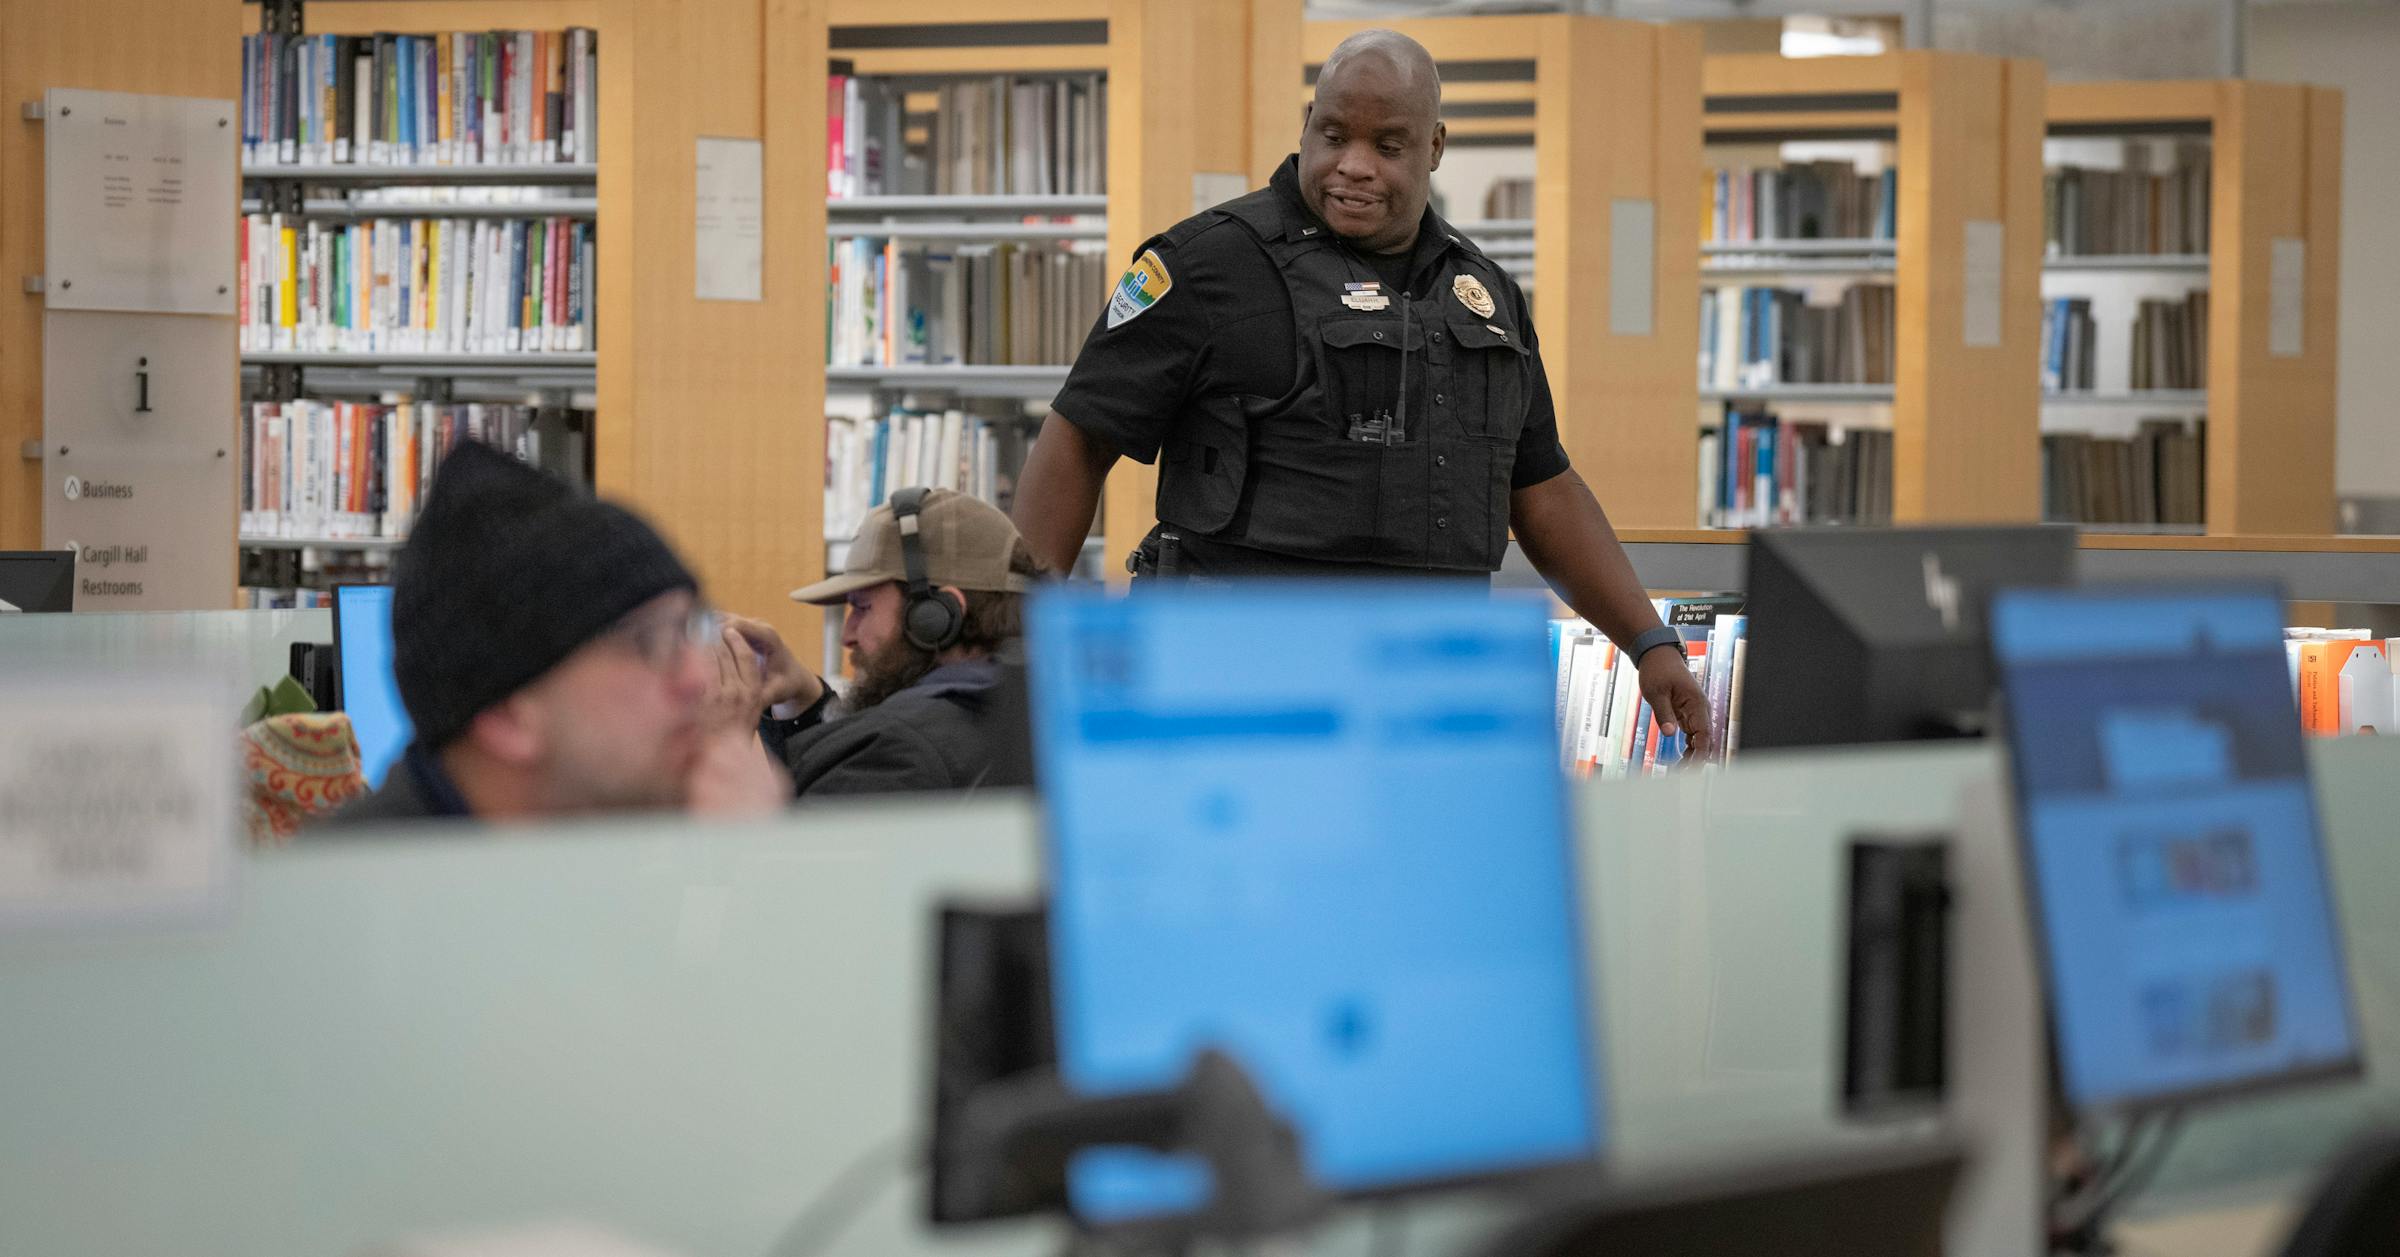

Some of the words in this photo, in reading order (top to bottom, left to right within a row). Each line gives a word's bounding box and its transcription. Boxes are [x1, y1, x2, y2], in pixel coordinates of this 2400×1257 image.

[1115, 292, 1136, 315] SECURITY
[135, 357, 152, 413] i
[83, 481, 134, 499] Business
[83, 545, 121, 568] Cargill
[125, 546, 148, 563] Hall
[82, 579, 143, 596] Restrooms
[1679, 604, 1688, 612] The
[1689, 604, 1713, 613] Revolution
[1695, 613, 1706, 622] April
